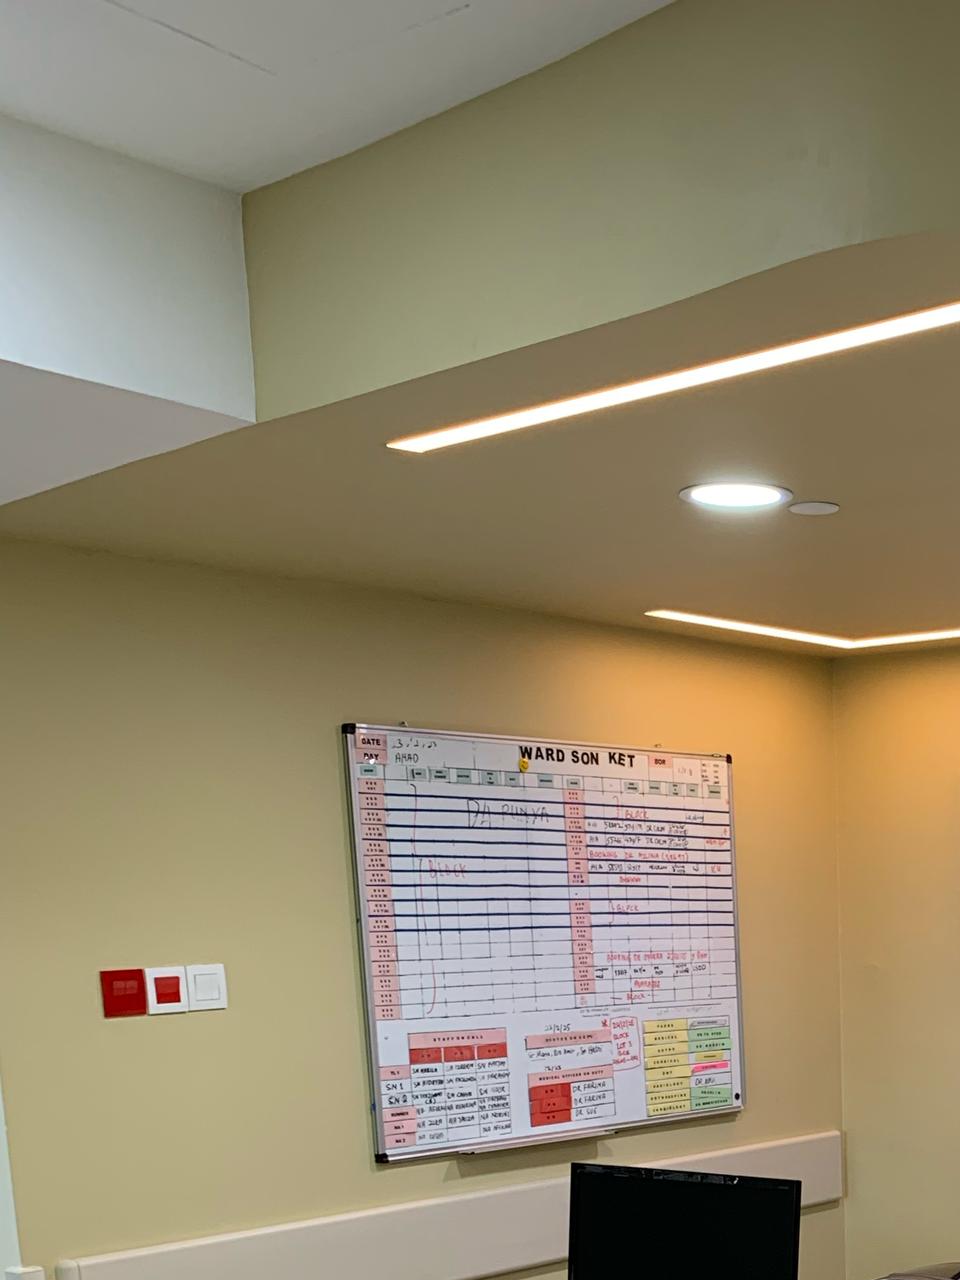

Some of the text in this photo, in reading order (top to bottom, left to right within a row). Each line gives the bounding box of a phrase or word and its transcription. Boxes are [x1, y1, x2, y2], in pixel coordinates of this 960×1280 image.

[363, 752, 379, 761] DAY
[519, 746, 635, 767] WARD SON KET
